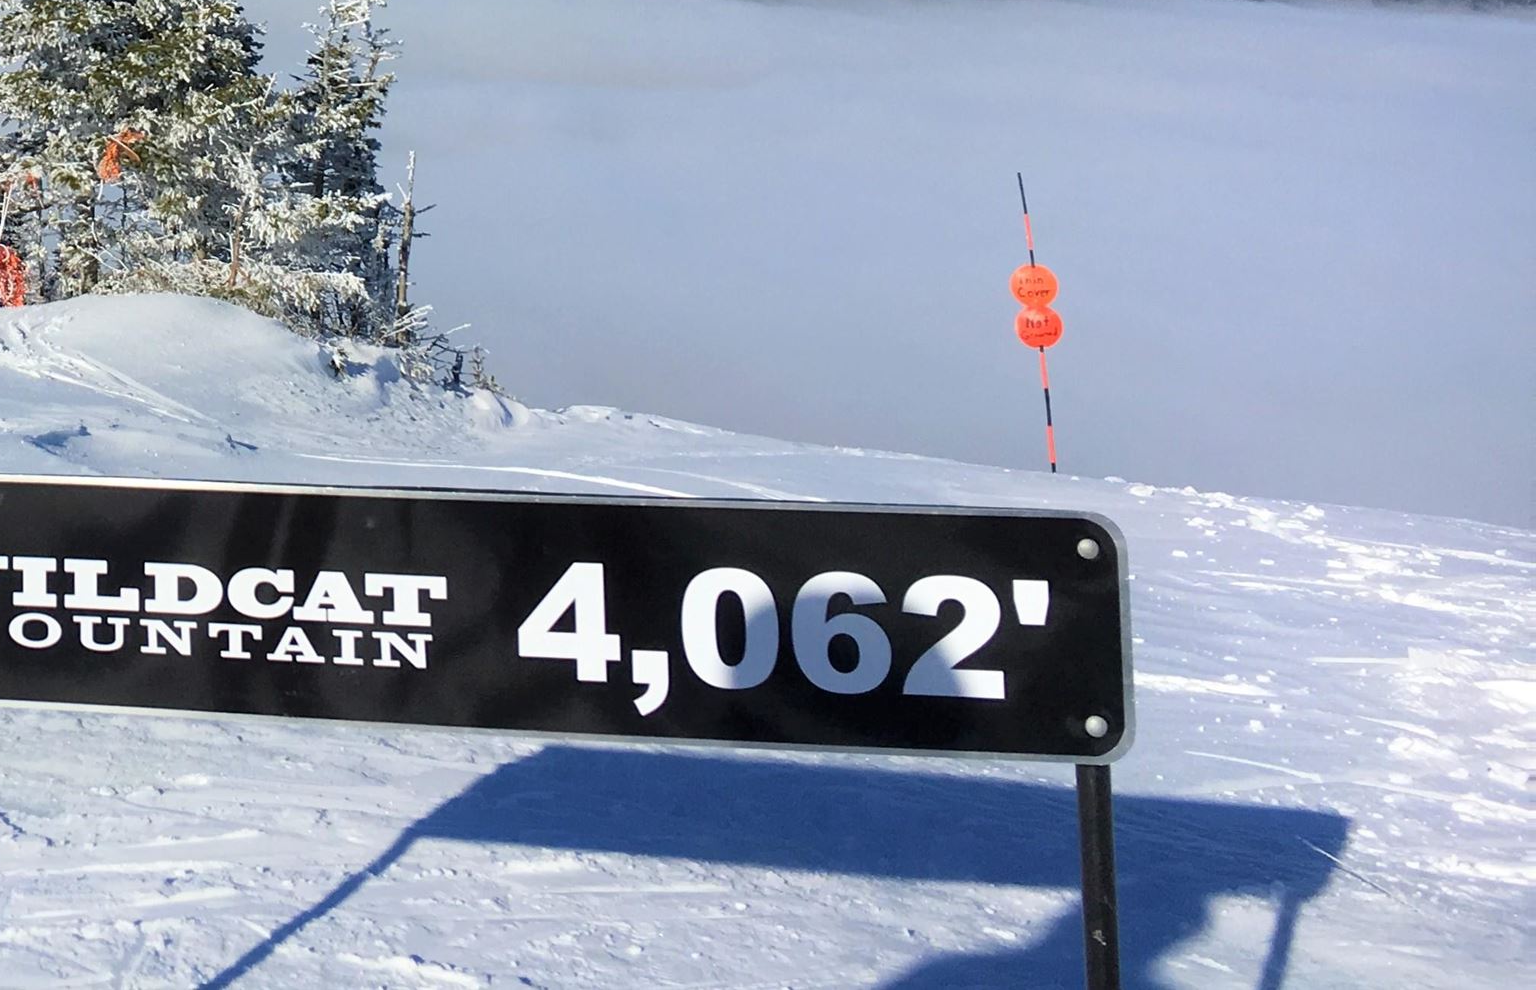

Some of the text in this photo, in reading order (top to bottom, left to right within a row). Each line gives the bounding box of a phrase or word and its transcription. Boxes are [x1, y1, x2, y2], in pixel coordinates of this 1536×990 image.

[1017, 286, 1049, 298] Cover
[1025, 315, 1049, 329] Not
[517, 561, 1050, 717] 4,062'
